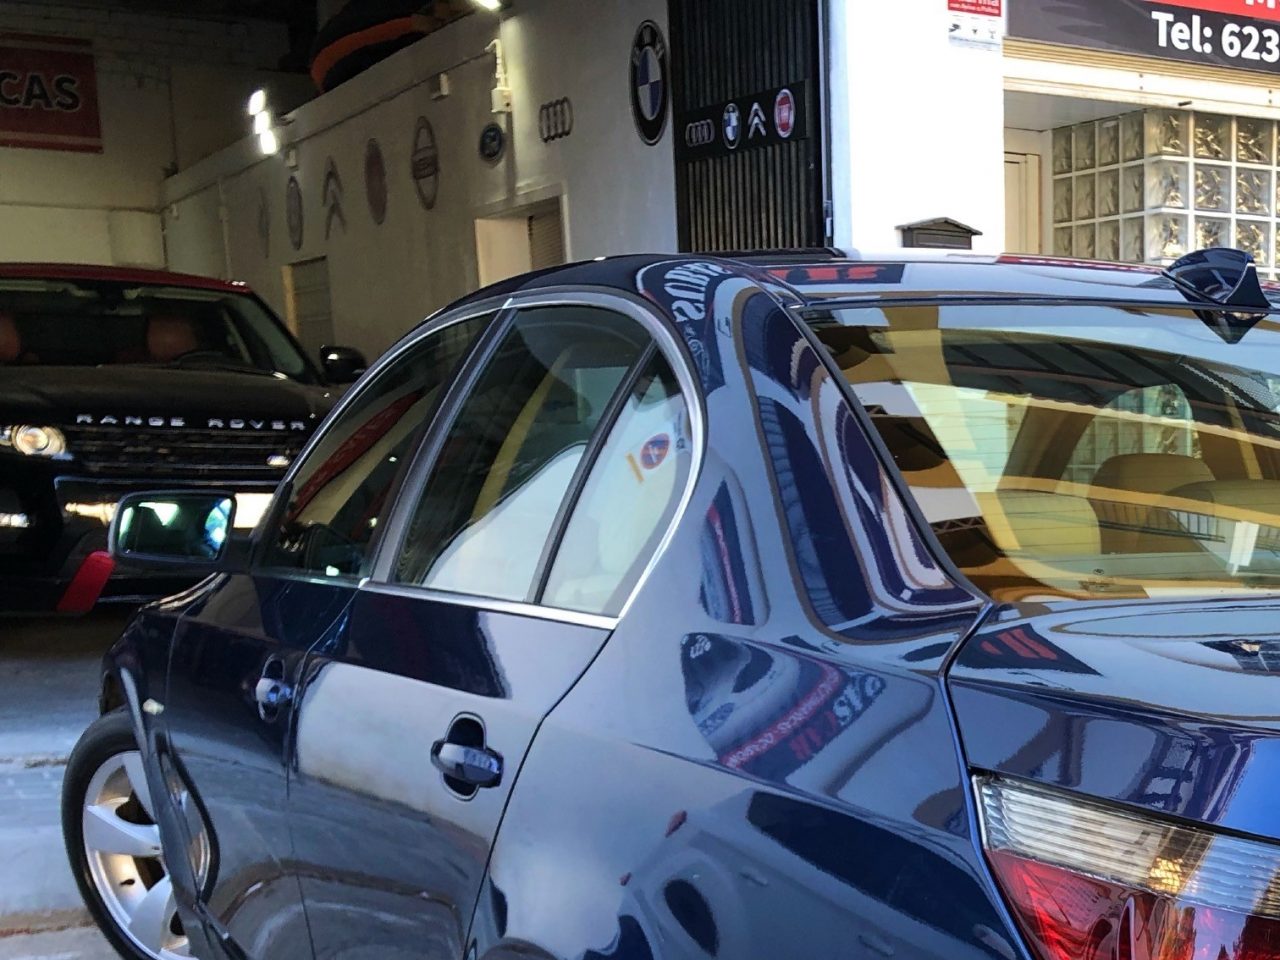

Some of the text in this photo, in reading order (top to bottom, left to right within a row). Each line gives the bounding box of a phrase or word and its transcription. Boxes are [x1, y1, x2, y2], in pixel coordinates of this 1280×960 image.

[1151, 11, 1213, 54] Tel:
[1221, 23, 1280, 63] 623
[76, 413, 306, 431] RANGE ROVER
